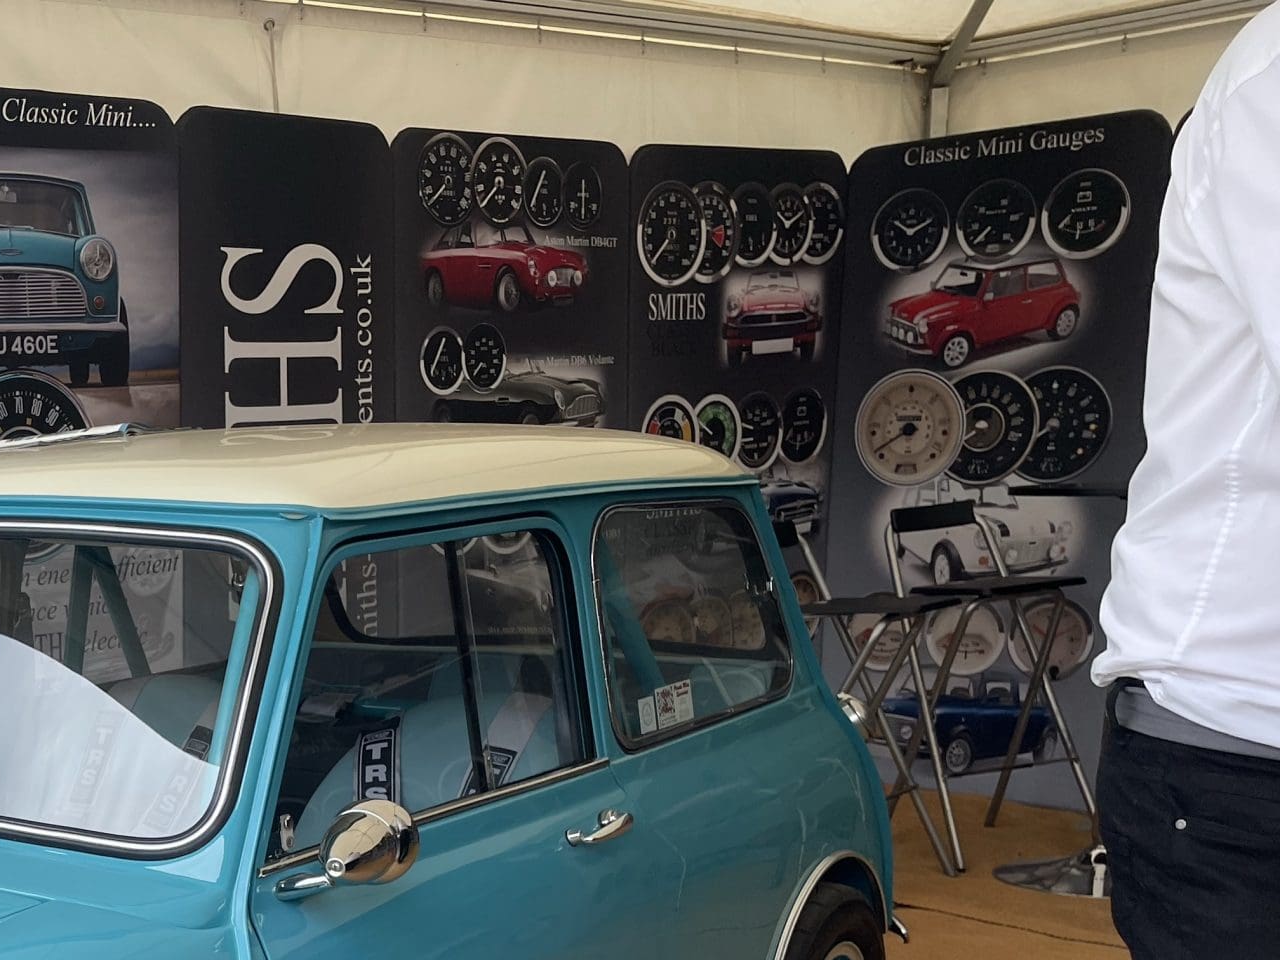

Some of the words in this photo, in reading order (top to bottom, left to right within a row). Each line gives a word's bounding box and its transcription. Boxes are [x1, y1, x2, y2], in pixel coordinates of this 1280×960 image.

[1, 98, 78, 126] Classic
[84, 102, 157, 127] Mini....
[903, 141, 972, 168] Classic
[976, 132, 1023, 159] Mini
[1030, 126, 1105, 153] Gauges
[566, 235, 590, 247] Martin
[648, 292, 706, 321] SMITHS
[15, 333, 60, 356] 460E
[350, 254, 374, 424] ents.co.uk
[14, 396, 24, 414] 70
[31, 398, 43, 417] 80
[45, 408, 60, 427] 90
[118, 554, 180, 582] fficient
[365, 742, 388, 800] TRS
